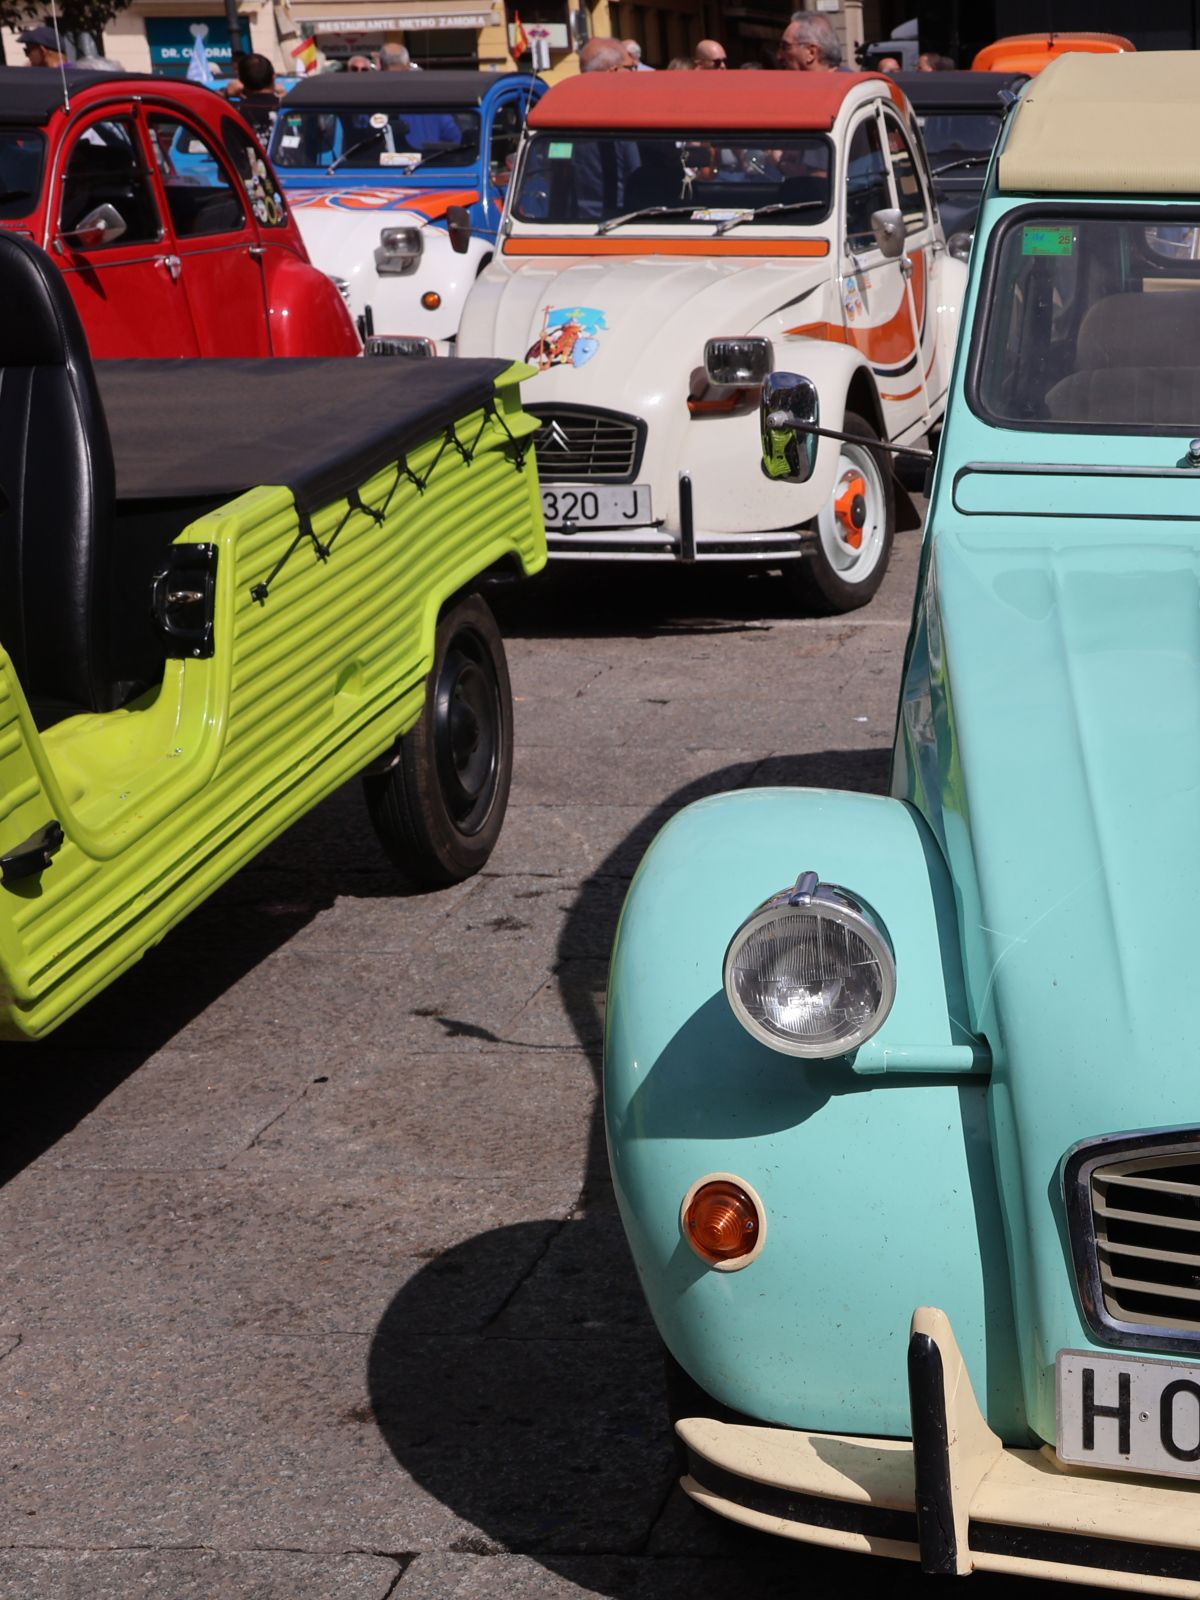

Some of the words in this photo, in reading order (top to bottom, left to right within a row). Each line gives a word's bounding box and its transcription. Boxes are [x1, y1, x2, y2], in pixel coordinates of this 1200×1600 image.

[318, 18, 395, 31] RESTAURANTE
[400, 17, 435, 29] METRO
[439, 16, 485, 27] ZAMORA
[543, 491, 599, 521] 320
[622, 490, 638, 519] J
[1082, 1368, 1131, 1455] H
